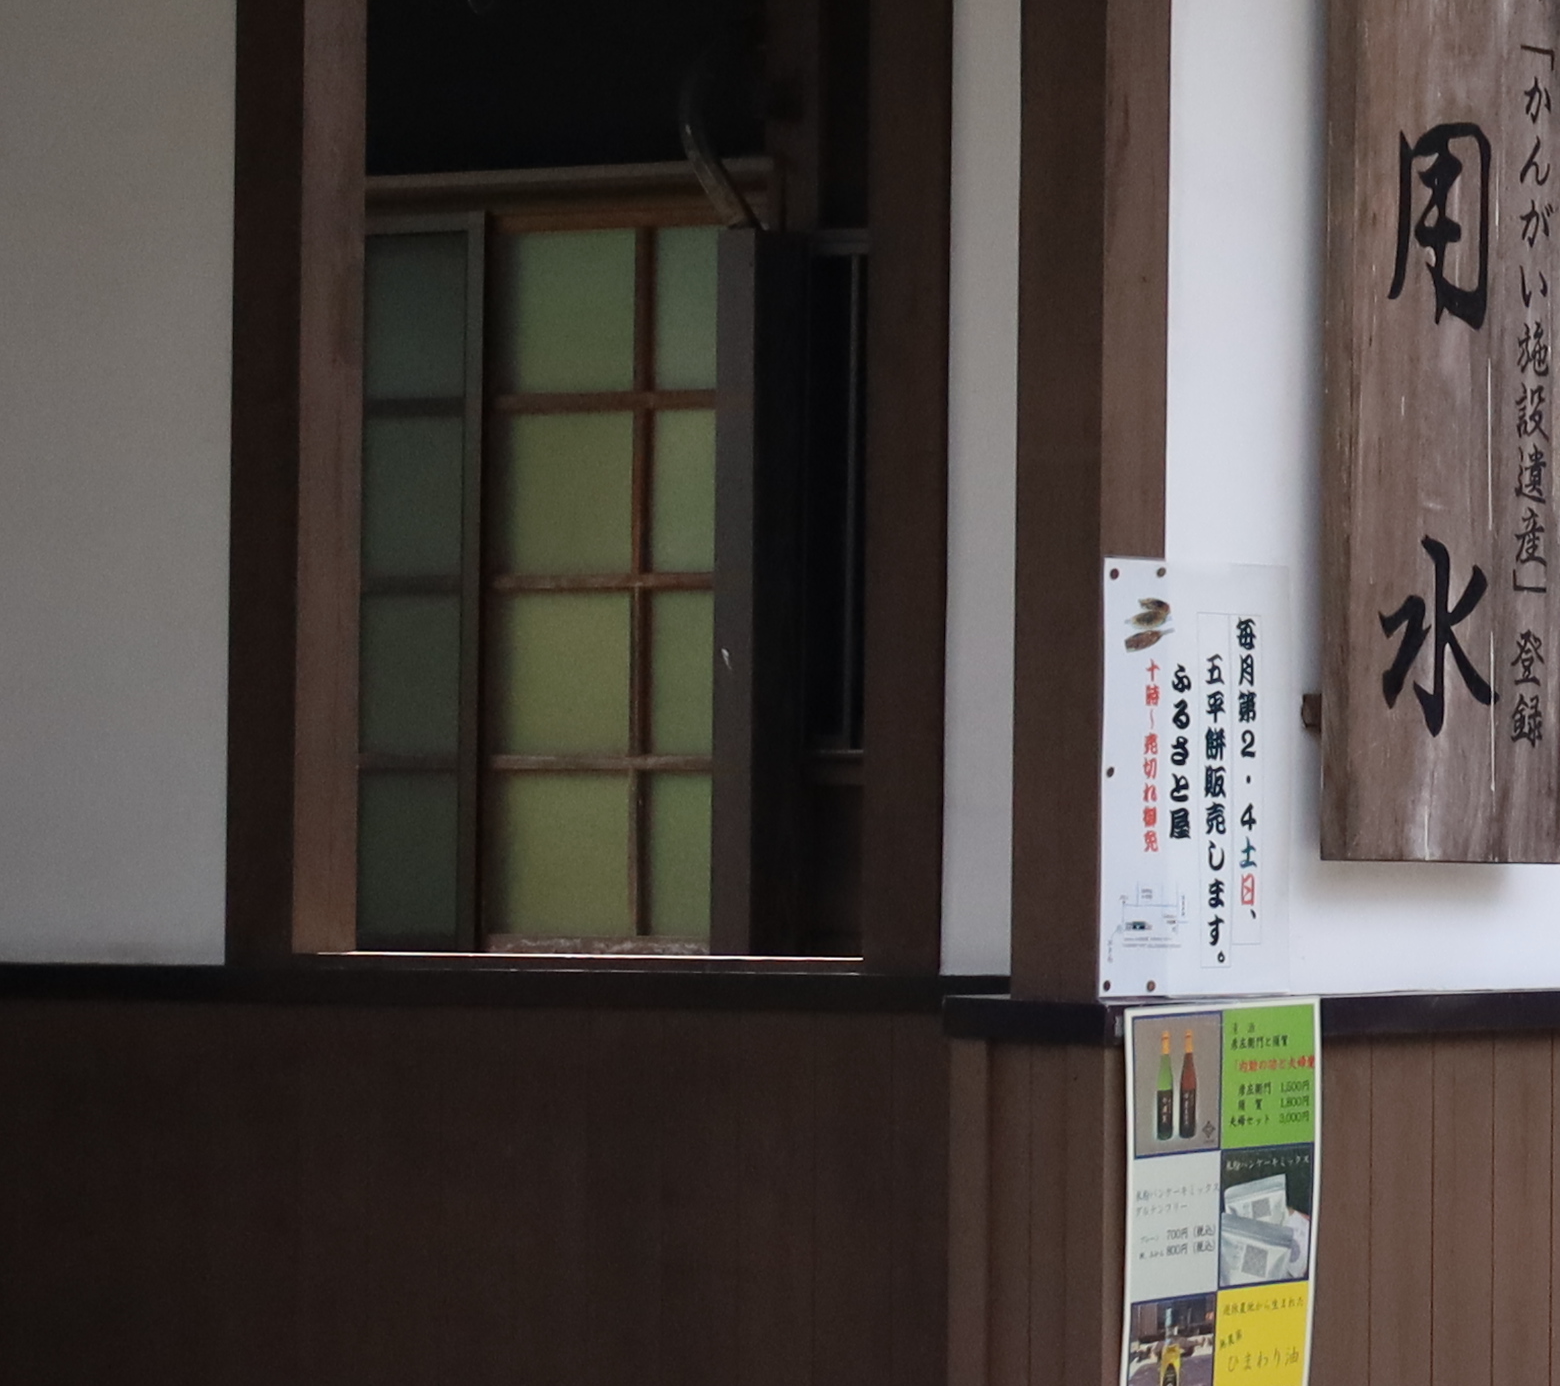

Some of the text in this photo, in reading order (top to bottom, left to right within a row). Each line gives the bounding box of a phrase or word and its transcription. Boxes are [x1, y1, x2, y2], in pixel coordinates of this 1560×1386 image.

[1168, 663, 1192, 841] ふるさと屋
[1204, 653, 1227, 963] 五平餅販売します。
[1227, 1346, 1299, 1372] ひまわり油
